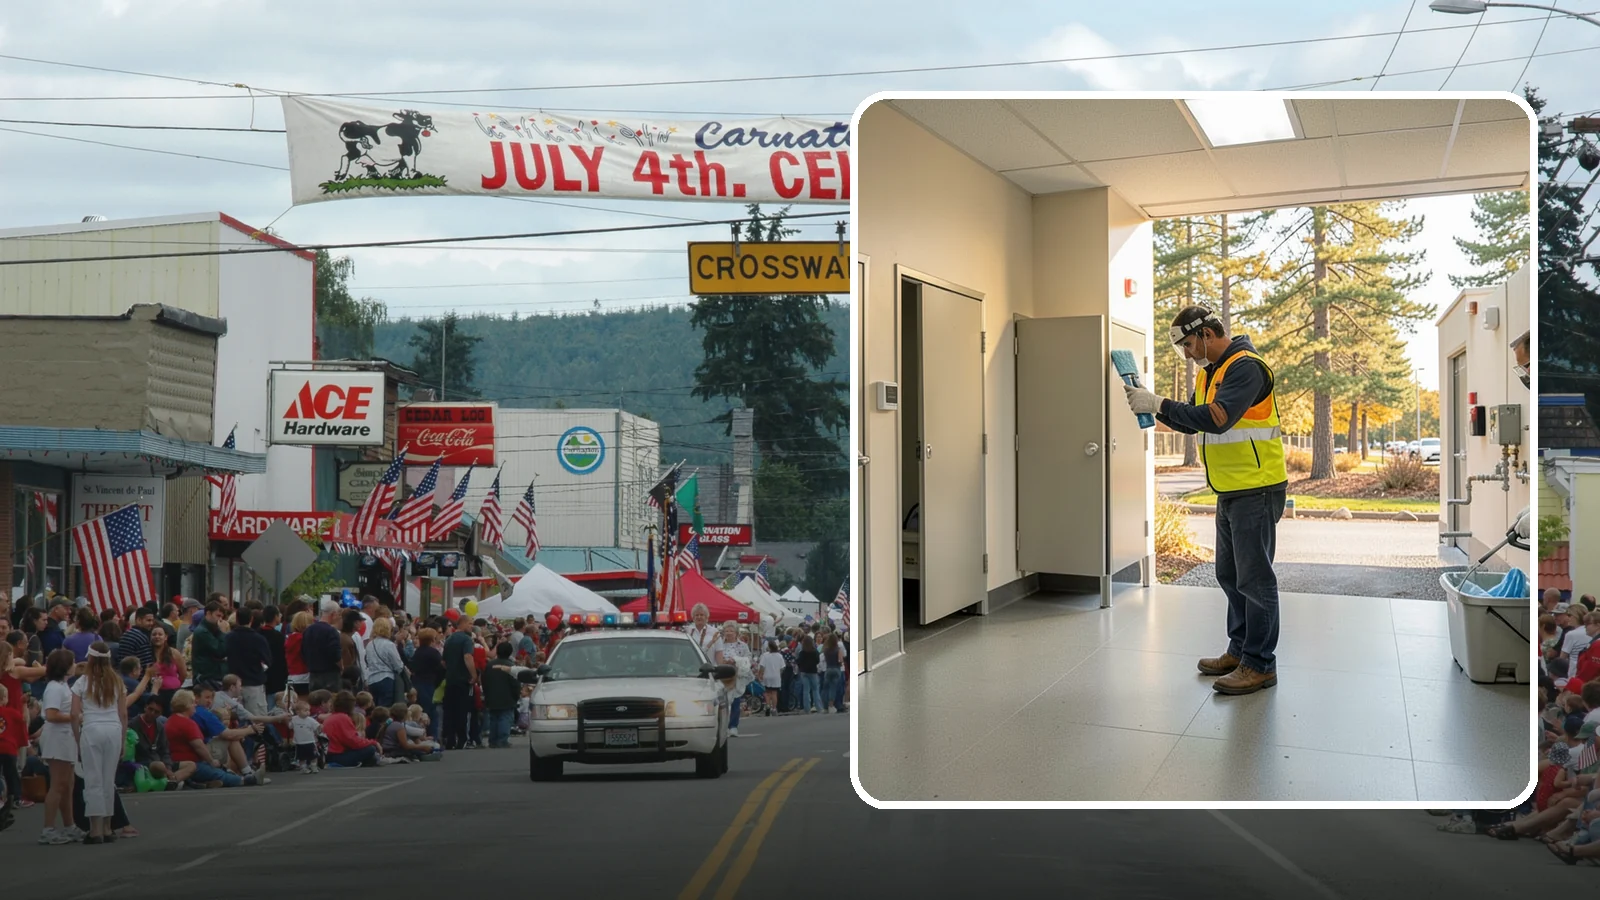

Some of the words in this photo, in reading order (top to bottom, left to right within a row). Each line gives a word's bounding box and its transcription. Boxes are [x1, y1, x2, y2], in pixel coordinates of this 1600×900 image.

[695, 121, 850, 150] Carnat
[481, 141, 604, 193] JULY
[632, 150, 746, 198] 4th.
[697, 254, 850, 280] CROSSWA
[283, 380, 373, 420] ACE
[405, 409, 453, 422] CEDAR
[460, 408, 485, 421] LOG
[283, 421, 371, 436] Hardware
[416, 428, 477, 447] Coca-Cola
[353, 467, 387, 480] Simpl
[83, 485, 93, 494] St.
[95, 485, 124, 494] Vincent
[126, 486, 136, 495] de
[137, 486, 155, 495] Paul
[688, 526, 741, 535] CRNATION
[699, 535, 730, 543] GLASS
